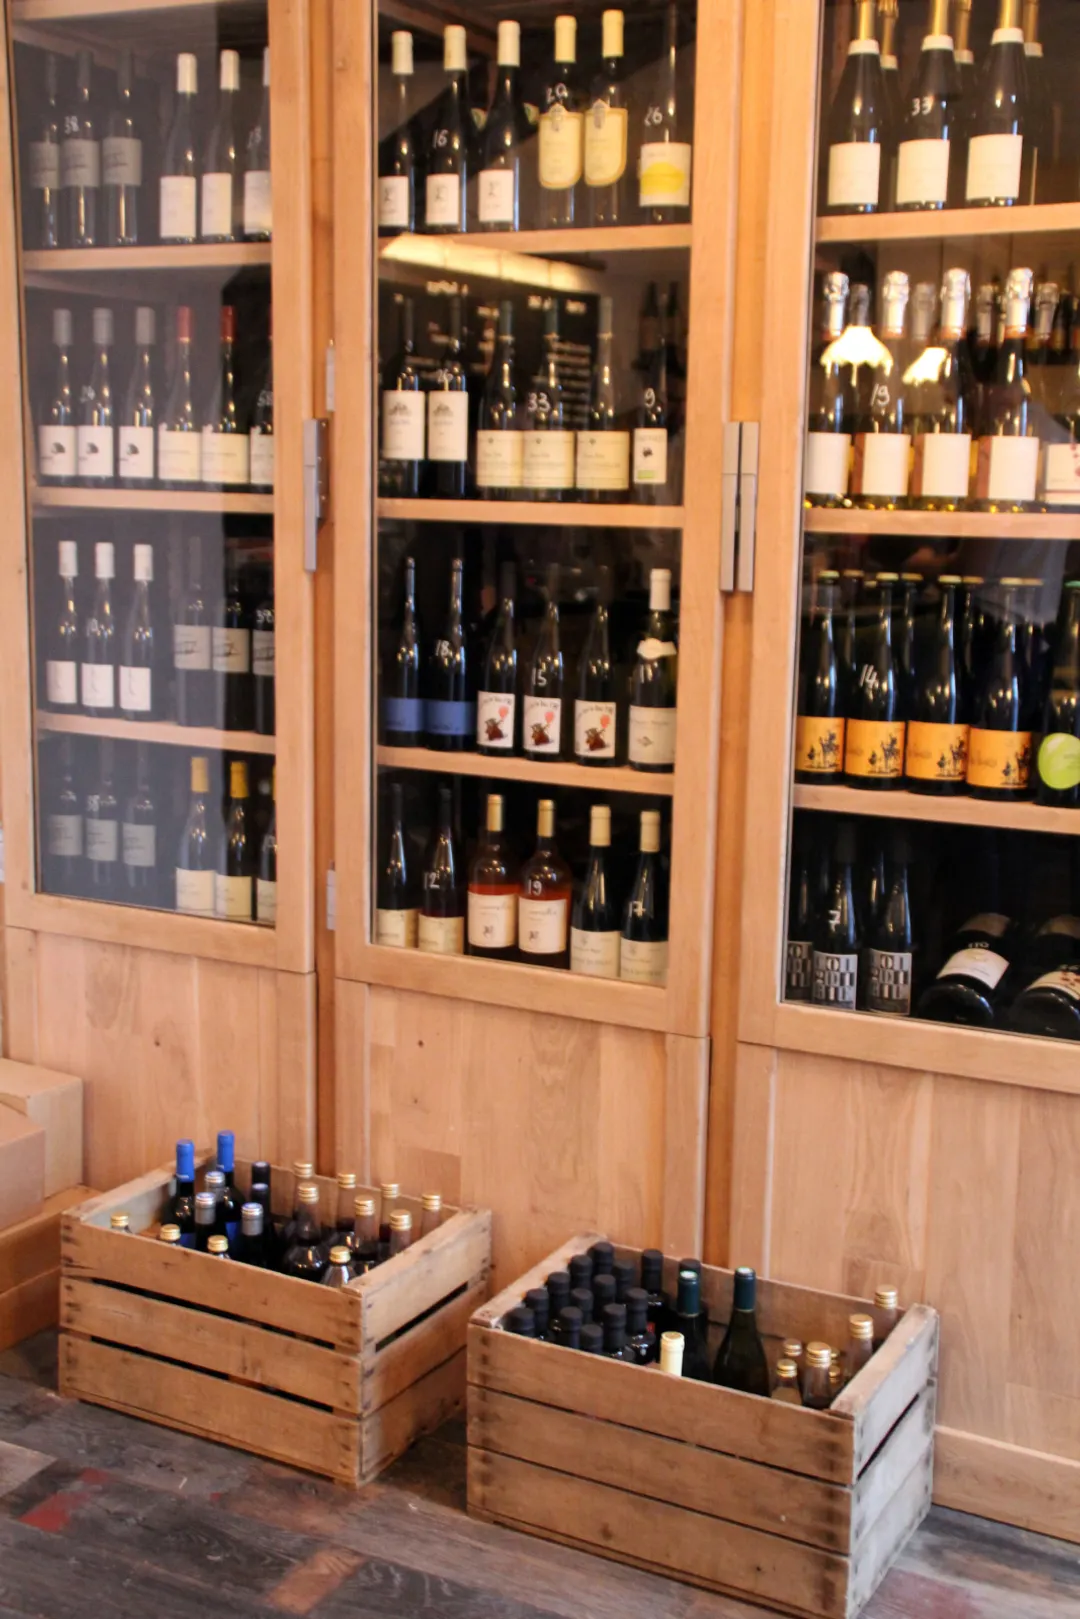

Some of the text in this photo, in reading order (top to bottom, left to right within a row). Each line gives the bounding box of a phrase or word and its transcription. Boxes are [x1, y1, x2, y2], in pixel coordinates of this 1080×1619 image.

[911, 95, 935, 117] 33
[433, 129, 449, 149] 16
[527, 391, 551, 413] 33
[644, 387, 656, 408] 9
[870, 383, 890, 407] 19
[532, 667, 547, 687] 15
[859, 664, 878, 687] 14
[423, 871, 441, 890] 12
[528, 879, 543, 897] 19
[828, 909, 841, 932] 7
